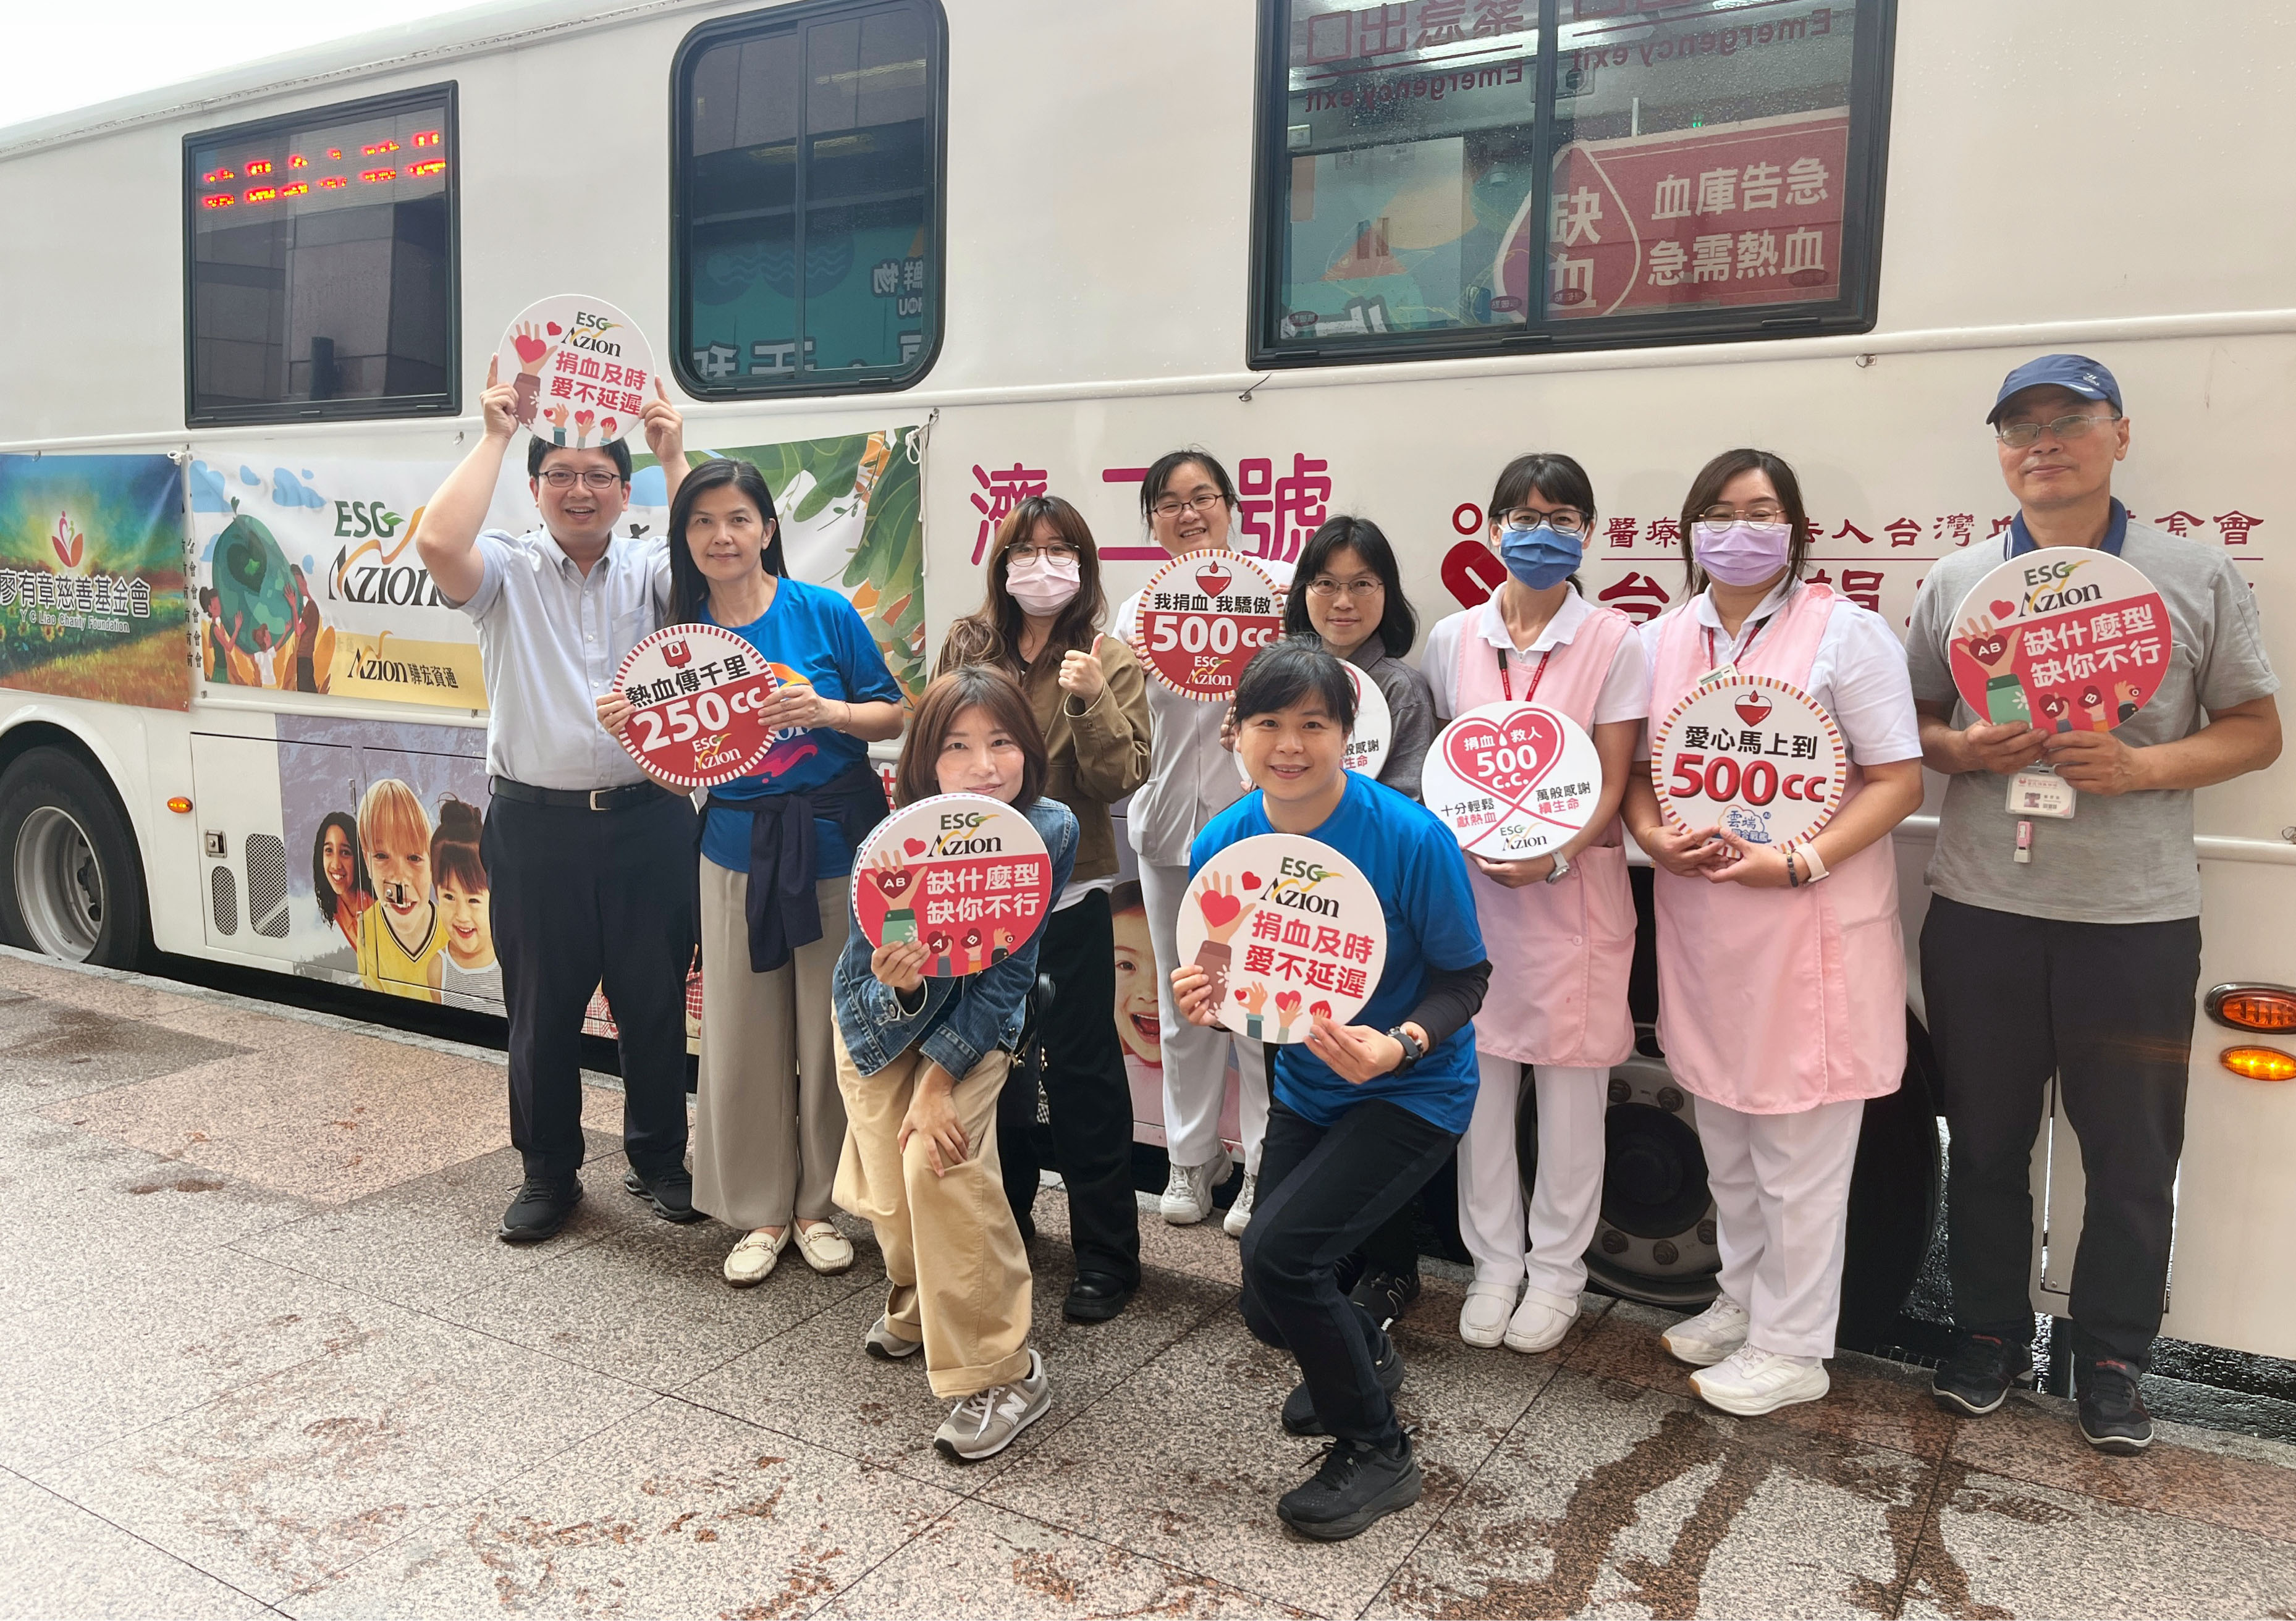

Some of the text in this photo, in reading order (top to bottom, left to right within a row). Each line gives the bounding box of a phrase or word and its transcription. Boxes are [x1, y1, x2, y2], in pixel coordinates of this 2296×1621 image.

[1651, 157, 1829, 221] 血庫告急
[1648, 226, 1825, 287] 急需熱血
[576, 311, 609, 331] ESG
[561, 327, 621, 358] Azion
[555, 350, 648, 391] 捐血及時
[551, 376, 643, 416] 愛不延遲
[334, 500, 395, 538] ESG
[2024, 561, 2069, 587] ESG
[0, 568, 150, 617] 廖有章慈善基金會
[1154, 593, 1271, 614] 我捐血 我驕傲
[2018, 583, 2102, 618] Azion
[20, 609, 130, 633] Y C Liao Charity Foundation
[2023, 604, 2156, 657] 缺什麼型
[1194, 656, 1220, 668] ESG
[1978, 642, 2001, 657] AB
[347, 648, 408, 683] Azion
[2030, 637, 2161, 688] 缺你不行
[625, 654, 750, 709] 熱血傳千里
[1186, 669, 1232, 686] Azion
[2046, 701, 2058, 712] A
[2085, 693, 2097, 704] B
[692, 735, 720, 752] ESG
[1463, 726, 1543, 752] 捐血 救人
[1684, 725, 1818, 760] 愛心馬上到
[693, 748, 741, 773] Azion
[1477, 744, 1537, 777] 500
[1535, 781, 1591, 801] 萬般感謝
[1441, 798, 1495, 817] 十分輕鬆
[1538, 798, 1579, 815] 續生命
[940, 812, 981, 830] ESG
[1456, 812, 1497, 828] 獻熱血
[1500, 825, 1524, 836] ESG
[1727, 810, 1756, 830] 雲端
[927, 835, 1002, 857] Azion
[1502, 835, 1547, 851] Azion
[927, 862, 1040, 895] 缺什麼型
[1280, 857, 1323, 882] ESG
[884, 877, 906, 888] AB
[927, 893, 1040, 924] 缺你不行
[1260, 878, 1339, 918] Azion
[932, 938, 943, 949] A
[967, 935, 978, 945] B
[1252, 910, 1375, 964] 捐血及時
[1244, 945, 1367, 999] 愛不延遲
